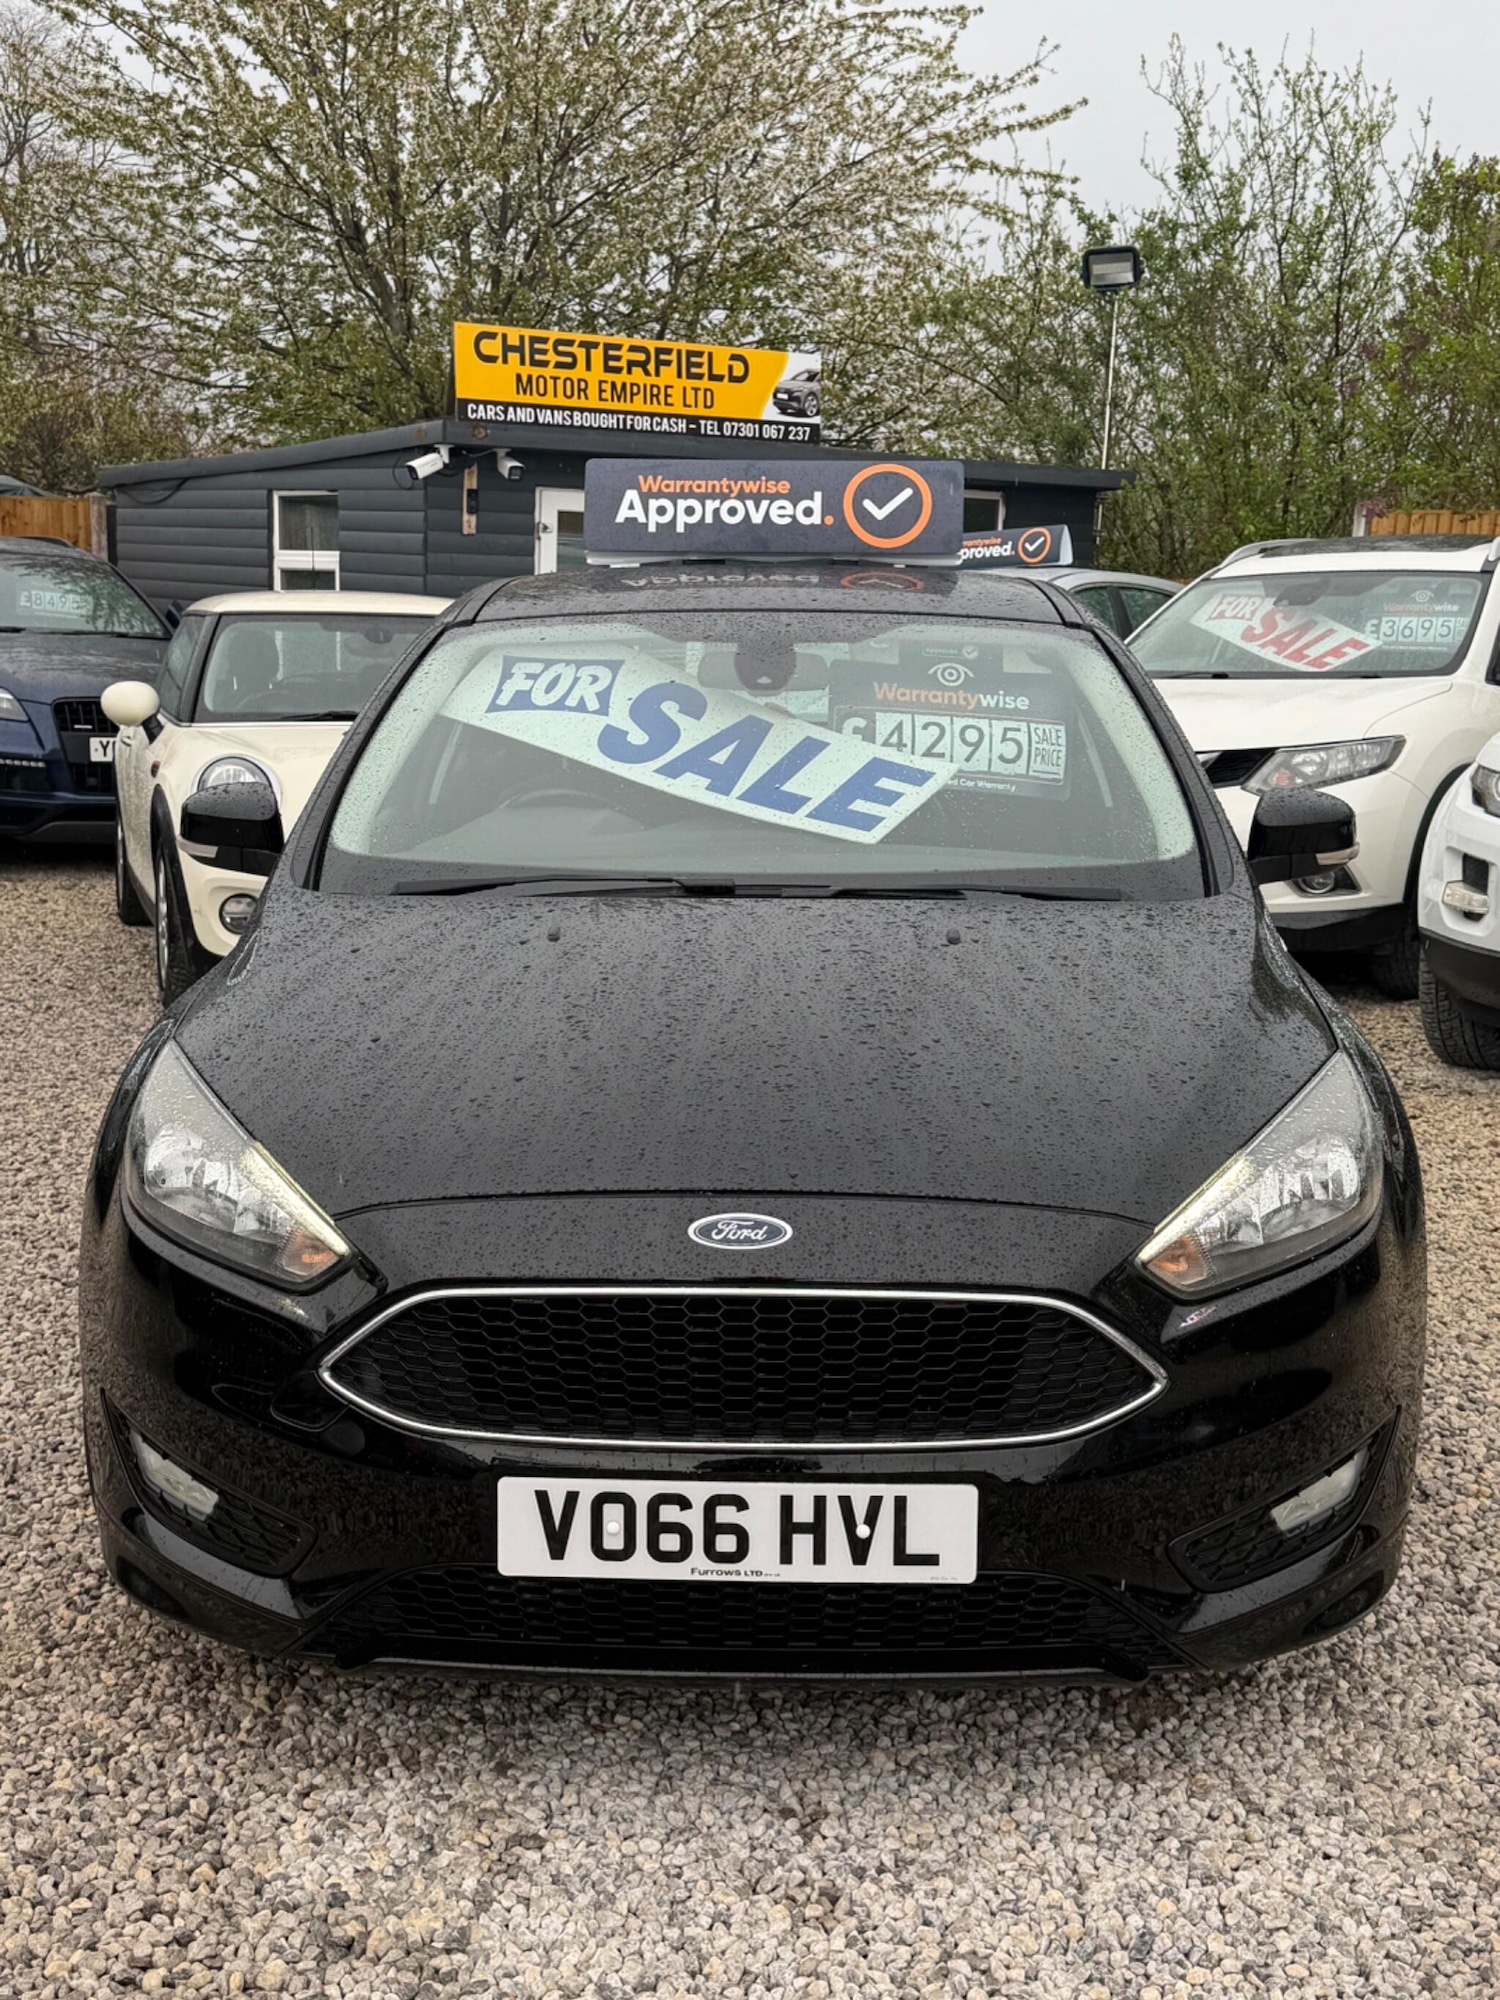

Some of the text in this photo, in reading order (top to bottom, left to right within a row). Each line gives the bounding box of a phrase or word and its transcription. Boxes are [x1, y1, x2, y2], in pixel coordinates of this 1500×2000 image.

[473, 331, 749, 383] CHESTERFIELD
[515, 374, 714, 409] MOTOR EMPIRE LTD
[467, 403, 505, 422] CARS
[506, 407, 535, 423] AND
[537, 408, 572, 425] VANS
[573, 411, 625, 430] BOUGHT
[626, 415, 651, 431] FOR
[652, 416, 686, 433] CASH
[700, 419, 721, 436] TEL
[723, 420, 760, 438] 07301
[762, 423, 784, 439] 067
[787, 424, 810, 441] 237
[637, 475, 791, 498] Warrantywise
[614, 489, 834, 533] Approved.
[959, 541, 1015, 559] proved.
[1210, 596, 1261, 619] FOR
[1241, 607, 1370, 669] SALE
[496, 662, 613, 712] FOR
[873, 681, 1030, 710] Warrantywise
[1034, 726, 1063, 747] SALE
[597, 681, 937, 832] SALE
[1034, 749, 1063, 768] PRICE
[711, 1220, 768, 1241] Ford
[779, 1495, 940, 1566] HVL
[690, 1567, 741, 1576] Furrows
